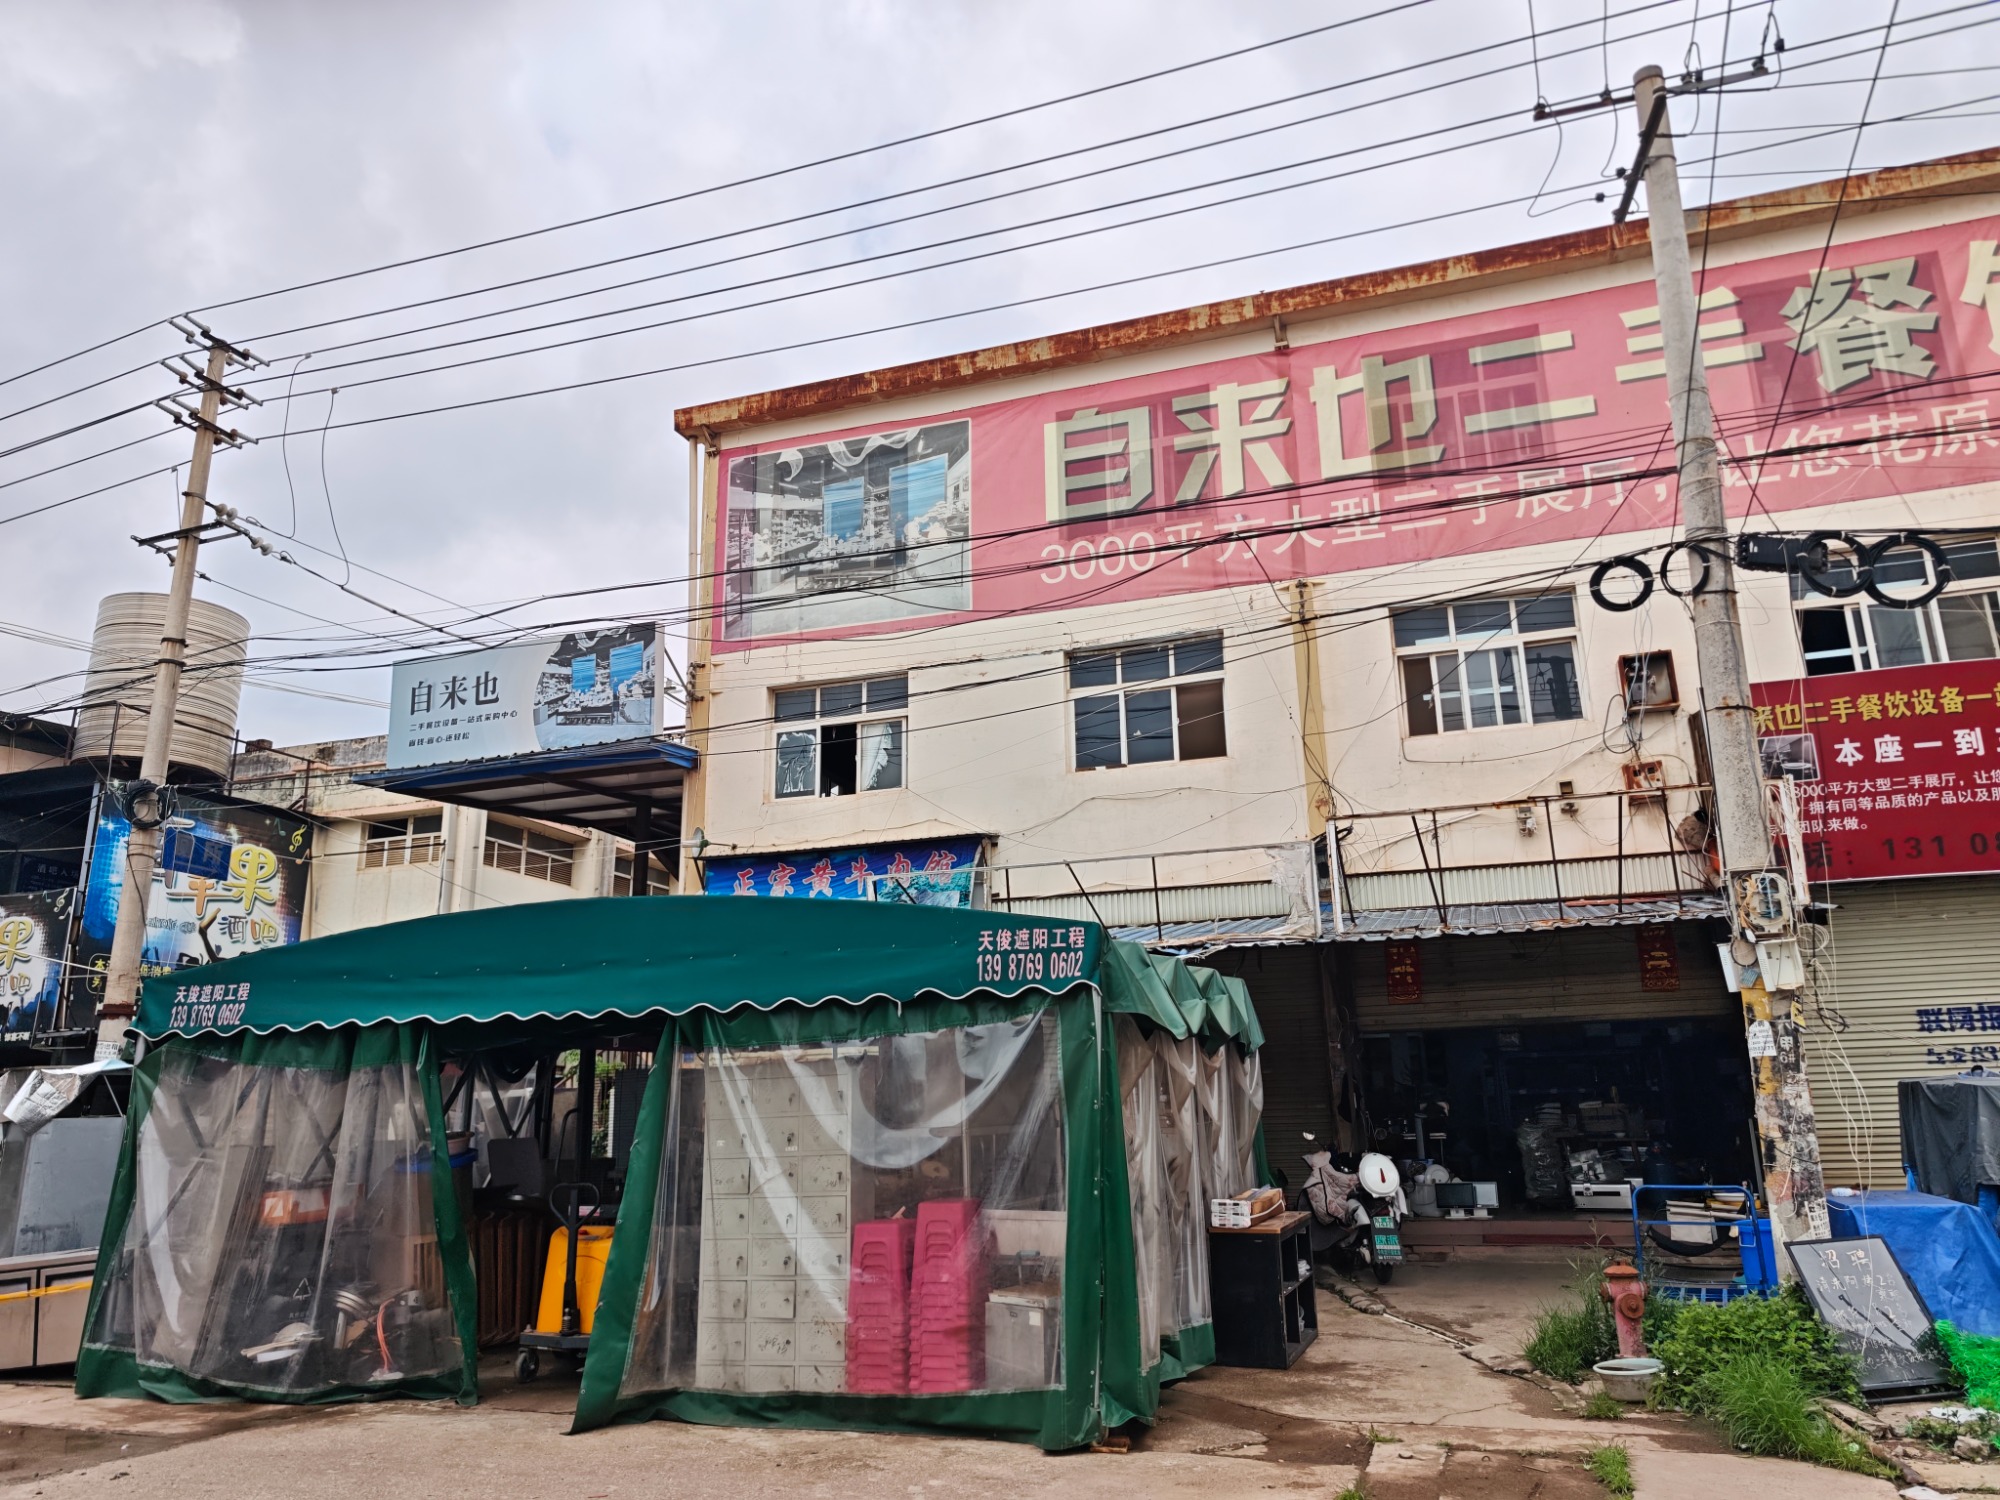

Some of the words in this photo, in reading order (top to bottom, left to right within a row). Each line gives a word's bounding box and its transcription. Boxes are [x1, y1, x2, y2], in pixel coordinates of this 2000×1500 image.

[410, 671, 500, 715] 自来也
[732, 851, 957, 899] 正宗黄牛肉馆
[221, 915, 278, 943] 酒吧
[978, 927, 1086, 952] 天俊遮阳工程
[976, 953, 1001, 982] 139
[1008, 952, 1043, 981] 8769
[1050, 950, 1083, 980] 0602
[175, 982, 251, 1003] 天俊遮阳工程
[169, 1006, 188, 1028] 139
[190, 1005, 215, 1027] 8769
[217, 1002, 244, 1026] 0602
